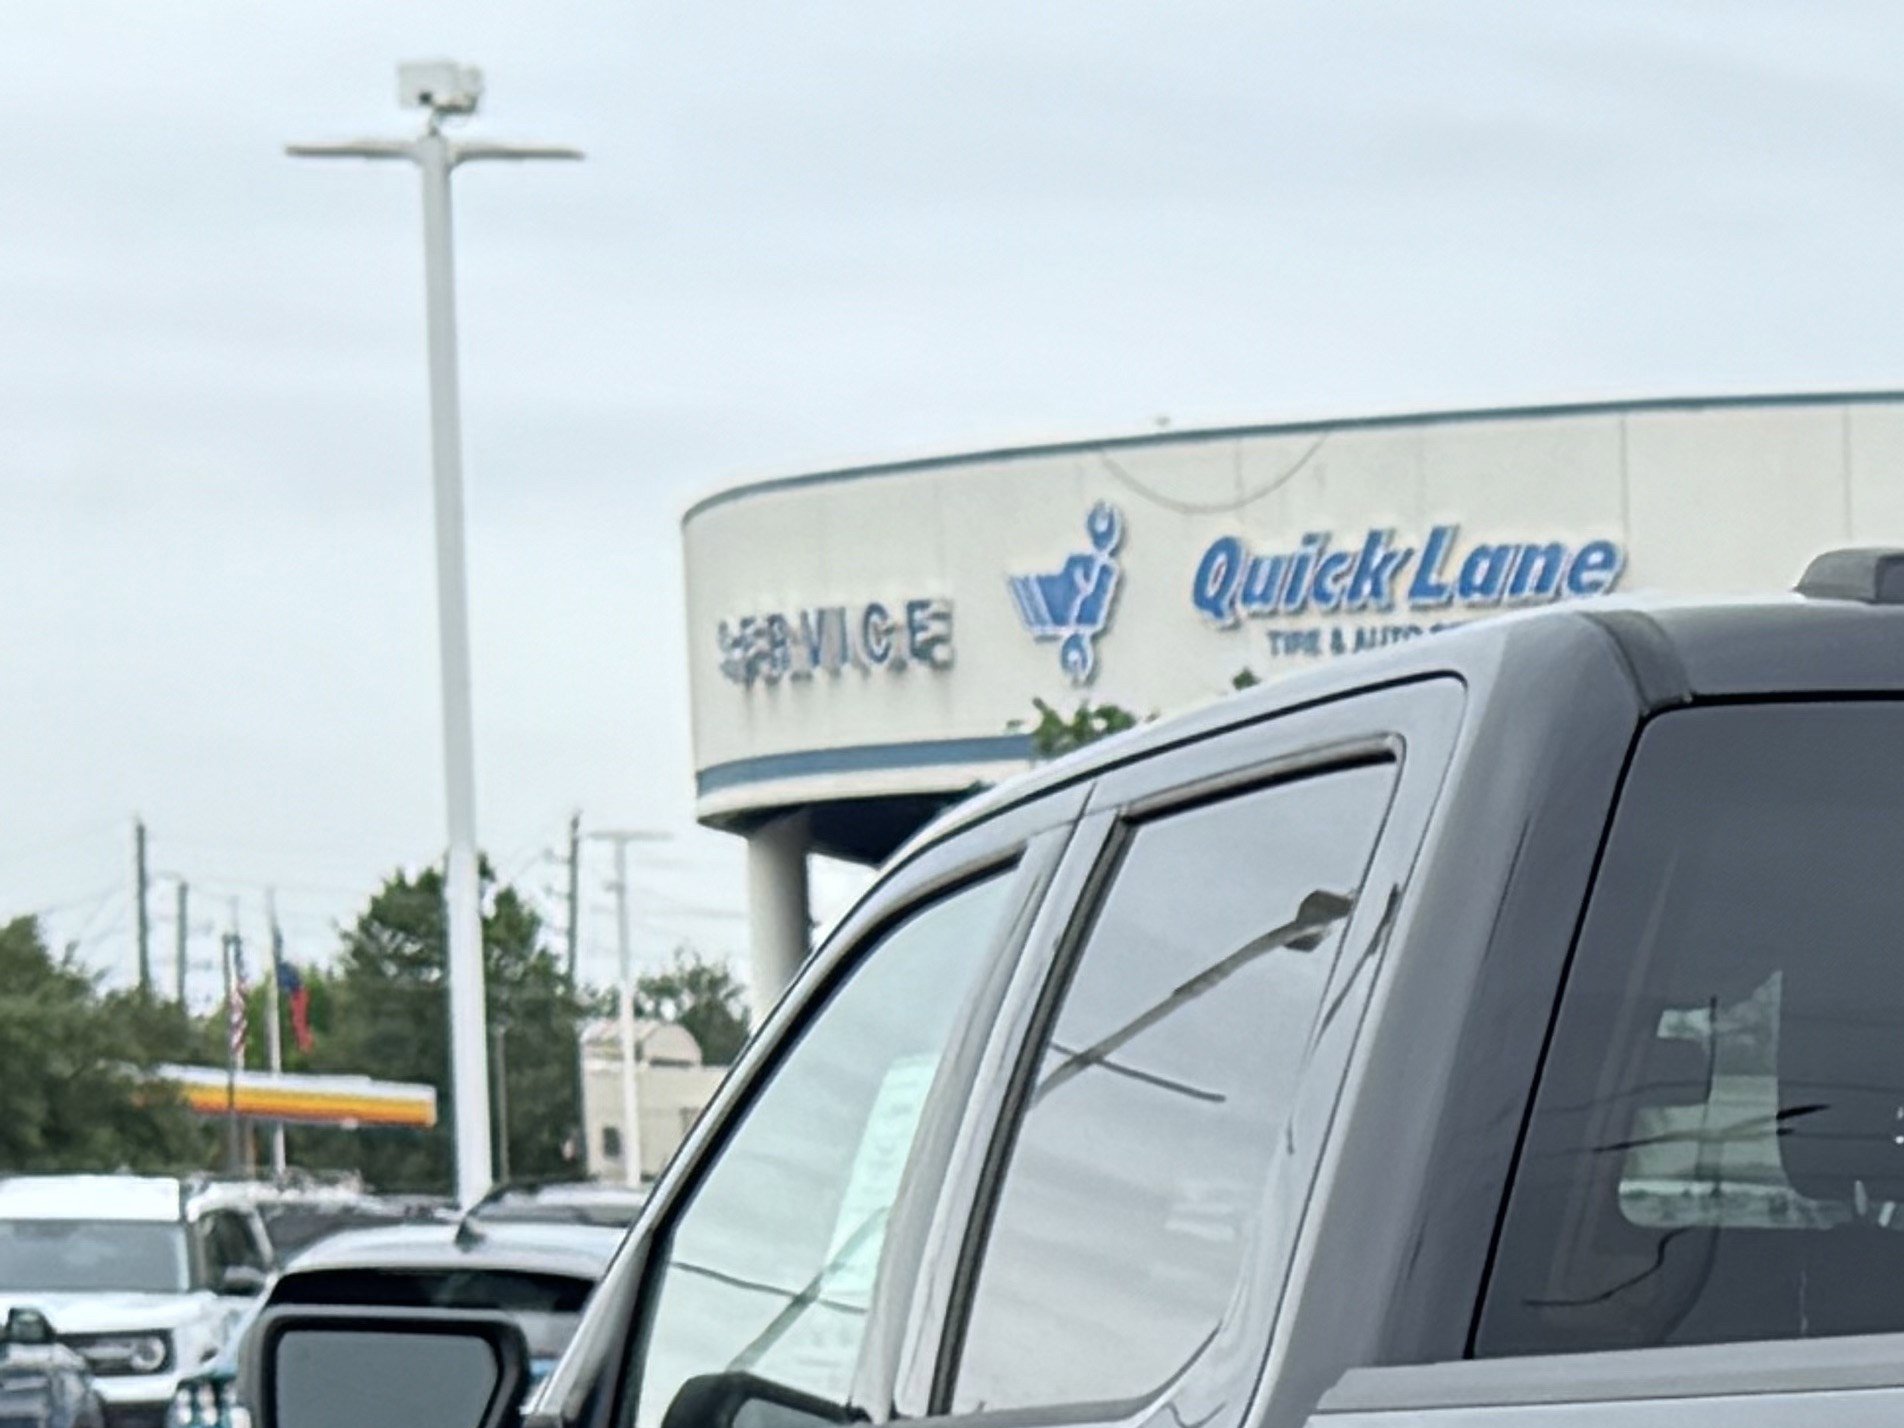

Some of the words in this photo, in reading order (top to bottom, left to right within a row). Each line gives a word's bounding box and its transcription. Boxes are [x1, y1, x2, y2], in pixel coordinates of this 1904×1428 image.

[1192, 528, 1408, 626] Quick
[1407, 525, 1626, 605] Lane
[1268, 626, 1323, 656] TIRE
